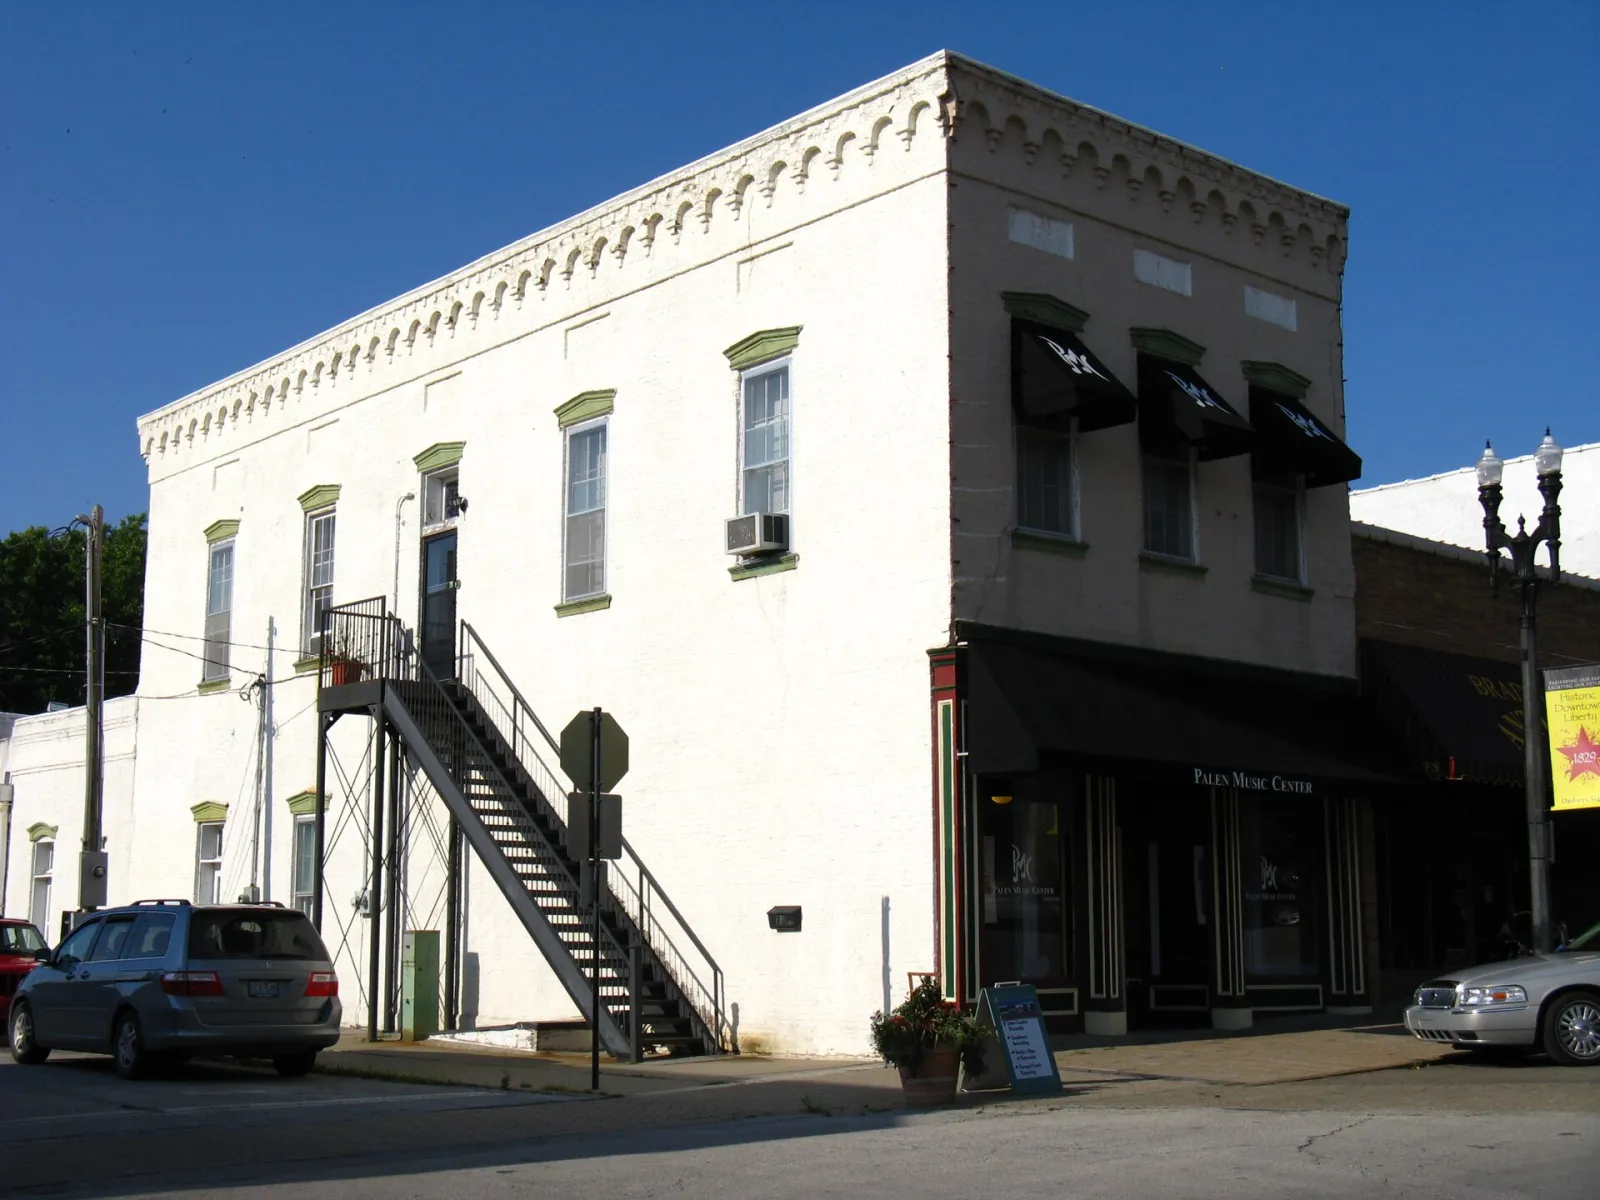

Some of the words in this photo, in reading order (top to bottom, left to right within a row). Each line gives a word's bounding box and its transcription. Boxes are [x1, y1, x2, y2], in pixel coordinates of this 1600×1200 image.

[1560, 692, 1595, 702] Historic
[1564, 712, 1597, 722] Liberty
[1573, 751, 1597, 764] 1829
[1193, 767, 1229, 787] PALEN
[1232, 771, 1269, 791] MUSIC
[1271, 775, 1313, 794] CENTER
